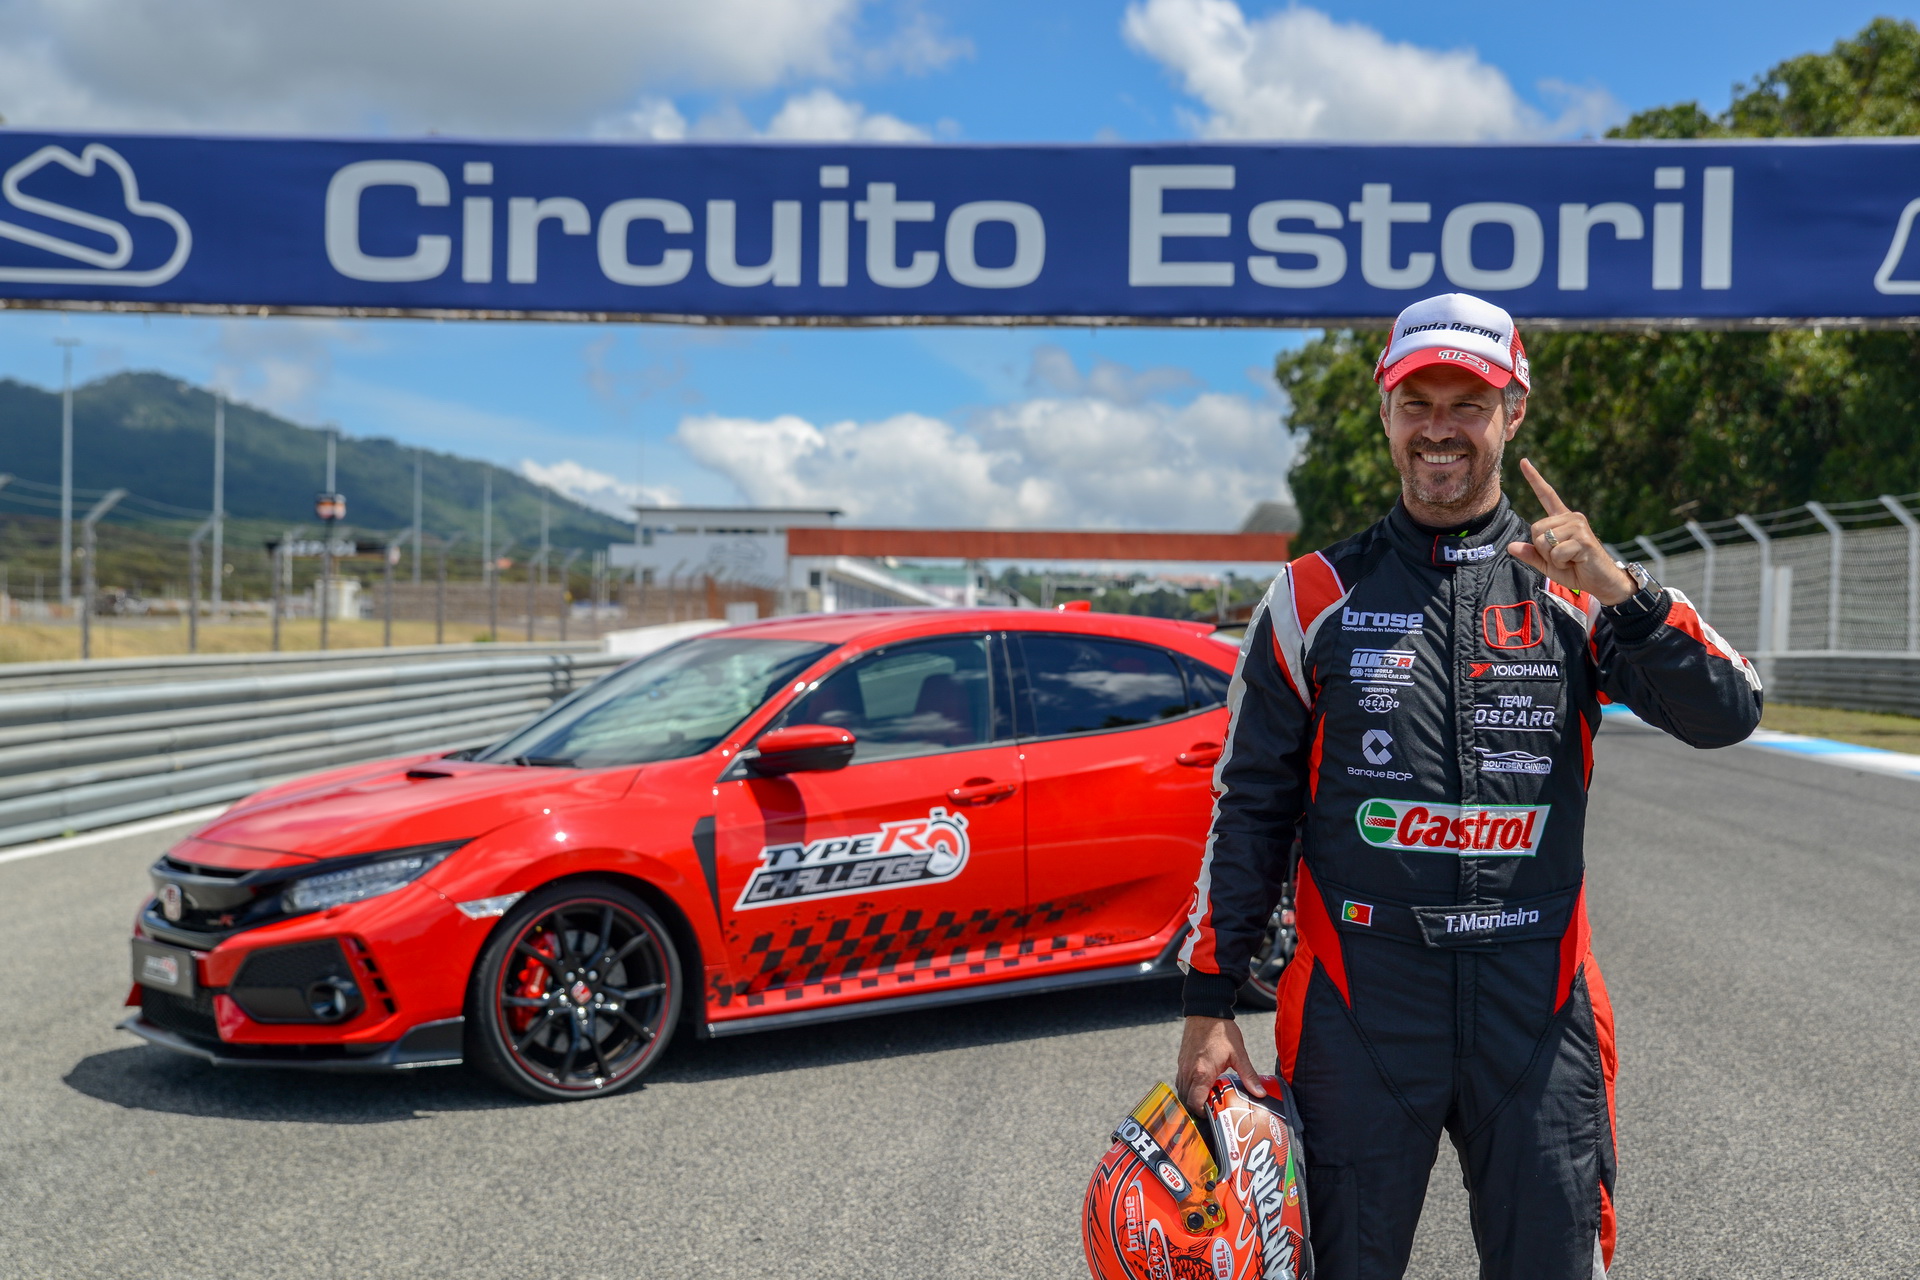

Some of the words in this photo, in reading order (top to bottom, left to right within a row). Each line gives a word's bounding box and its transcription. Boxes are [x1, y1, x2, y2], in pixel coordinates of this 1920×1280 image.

[325, 159, 1046, 288] Circuito
[1129, 164, 1734, 290] Estoril
[1402, 322, 1447, 338] Honda
[1450, 322, 1502, 343] Racing
[1443, 544, 1496, 562] brose
[1341, 606, 1424, 629] brose
[1491, 664, 1559, 677] YOKOHAMA
[1358, 699, 1400, 709] OSCARO
[1497, 695, 1533, 708] TEAM
[1474, 709, 1555, 727] OSCARO
[1347, 766, 1386, 778] Banque
[1386, 771, 1413, 781] BCP
[1482, 760, 1523, 770] BOUTSEN
[1397, 806, 1537, 851] Castrol
[765, 837, 876, 867] TYPE
[878, 823, 930, 853] R
[747, 856, 930, 901] CHALLENGE
[1444, 908, 1539, 933] T.Monteiro
[1162, 1166, 1182, 1189] BELL
[1246, 1138, 1295, 1280] ONTEIRO
[1125, 1195, 1140, 1252] brose
[1151, 1247, 1163, 1279] CARO
[1215, 1244, 1229, 1278] BELL
